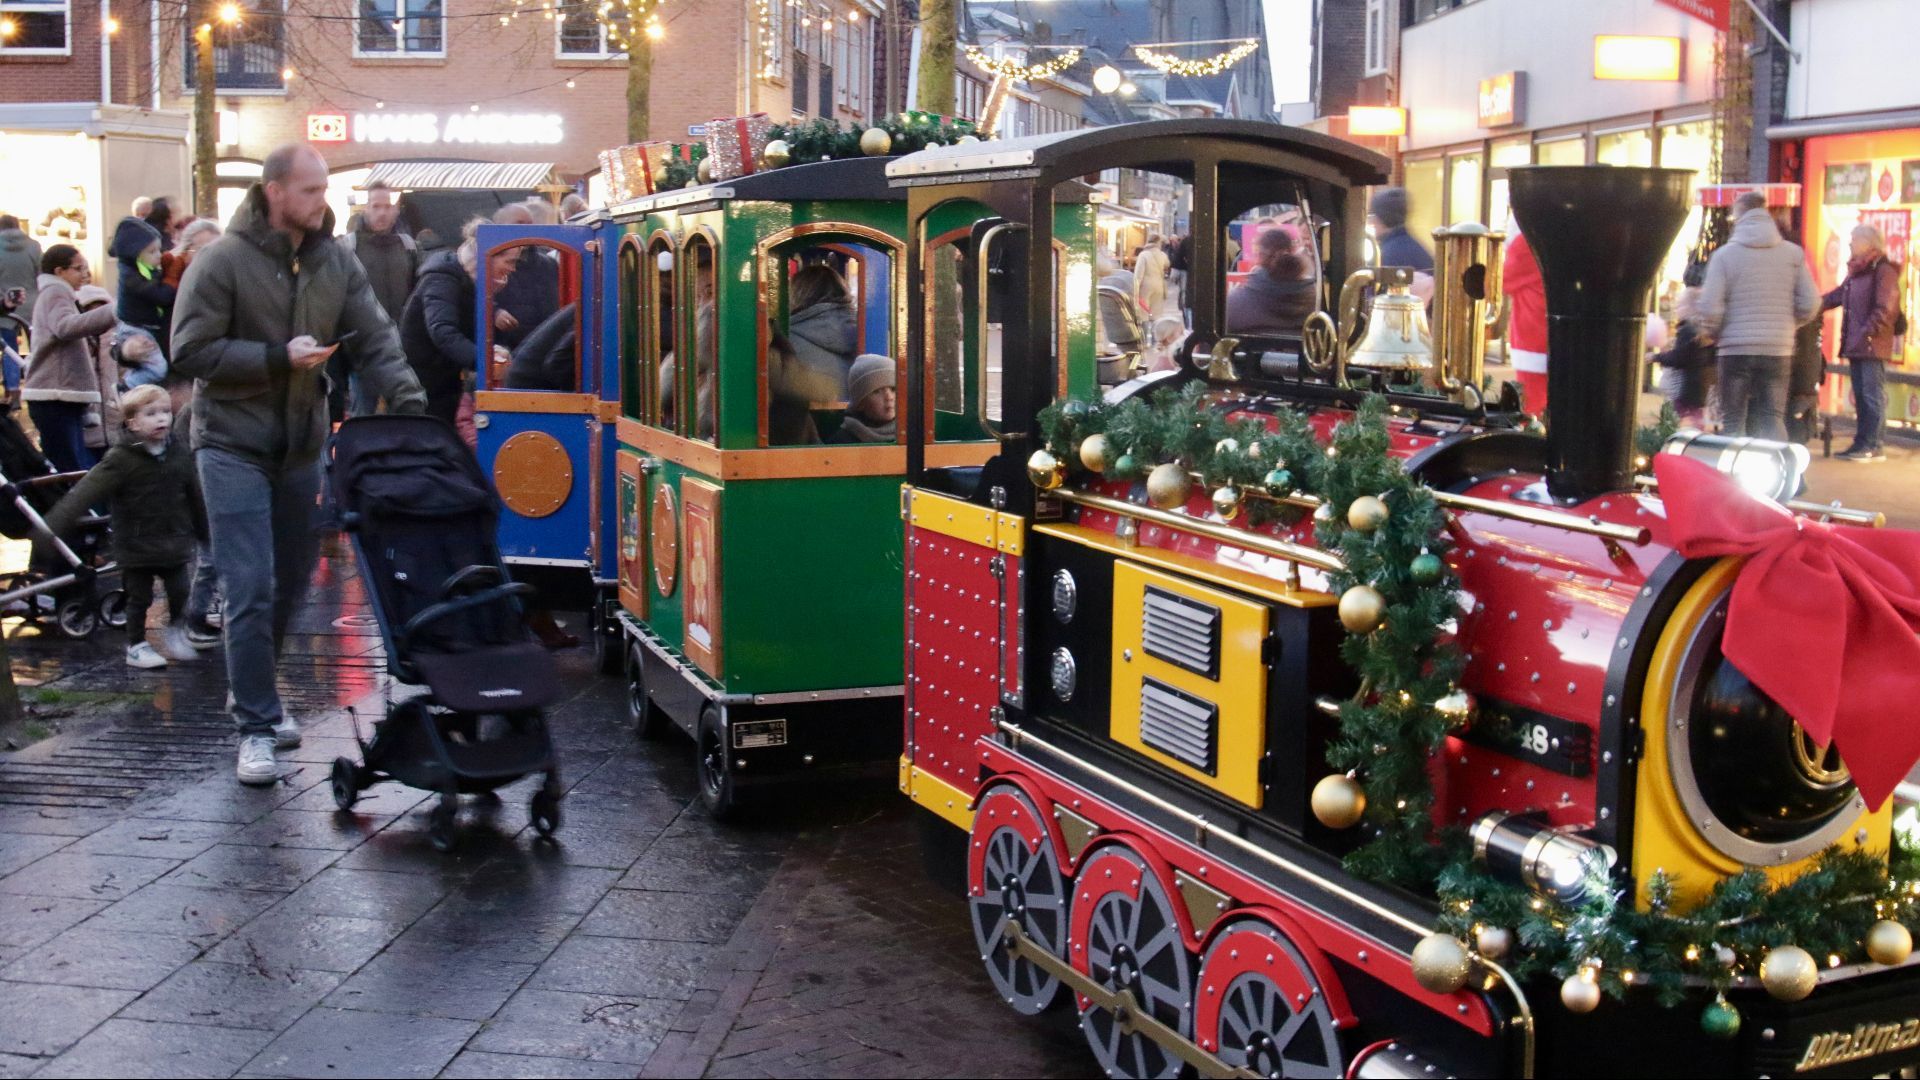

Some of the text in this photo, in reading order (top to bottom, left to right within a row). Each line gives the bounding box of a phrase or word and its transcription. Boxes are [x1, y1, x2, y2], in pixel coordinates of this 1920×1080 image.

[354, 113, 564, 143] HANS ANDERS
[1795, 1018, 1920, 1071] Wattma
